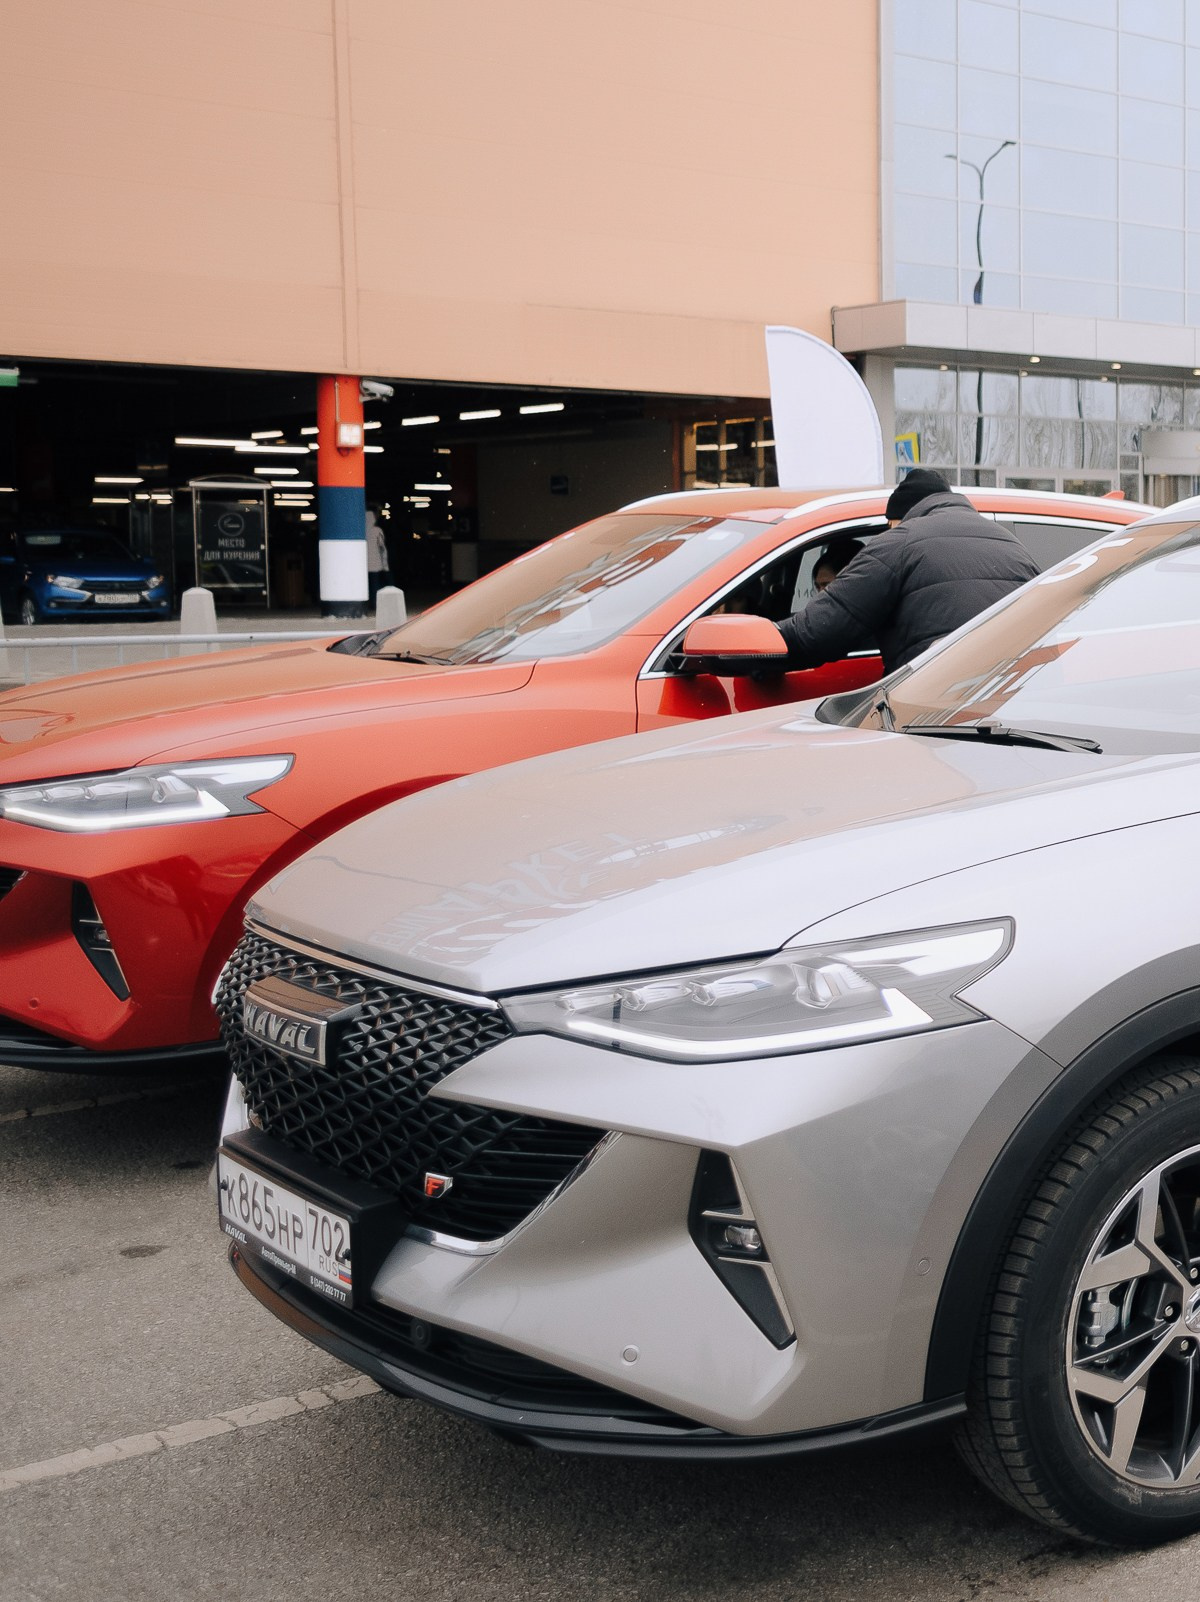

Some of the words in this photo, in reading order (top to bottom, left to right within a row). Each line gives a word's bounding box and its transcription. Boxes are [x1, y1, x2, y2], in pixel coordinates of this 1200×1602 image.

[217, 537, 245, 548] МЕСТО
[203, 551, 221, 561] ДЛЯ
[223, 550, 260, 561] КУРЕНИЯ
[244, 1002, 315, 1054] HAVAL
[225, 1223, 248, 1244] HAVAL
[308, 1207, 346, 1263] 702
[318, 1255, 338, 1277] RUS
